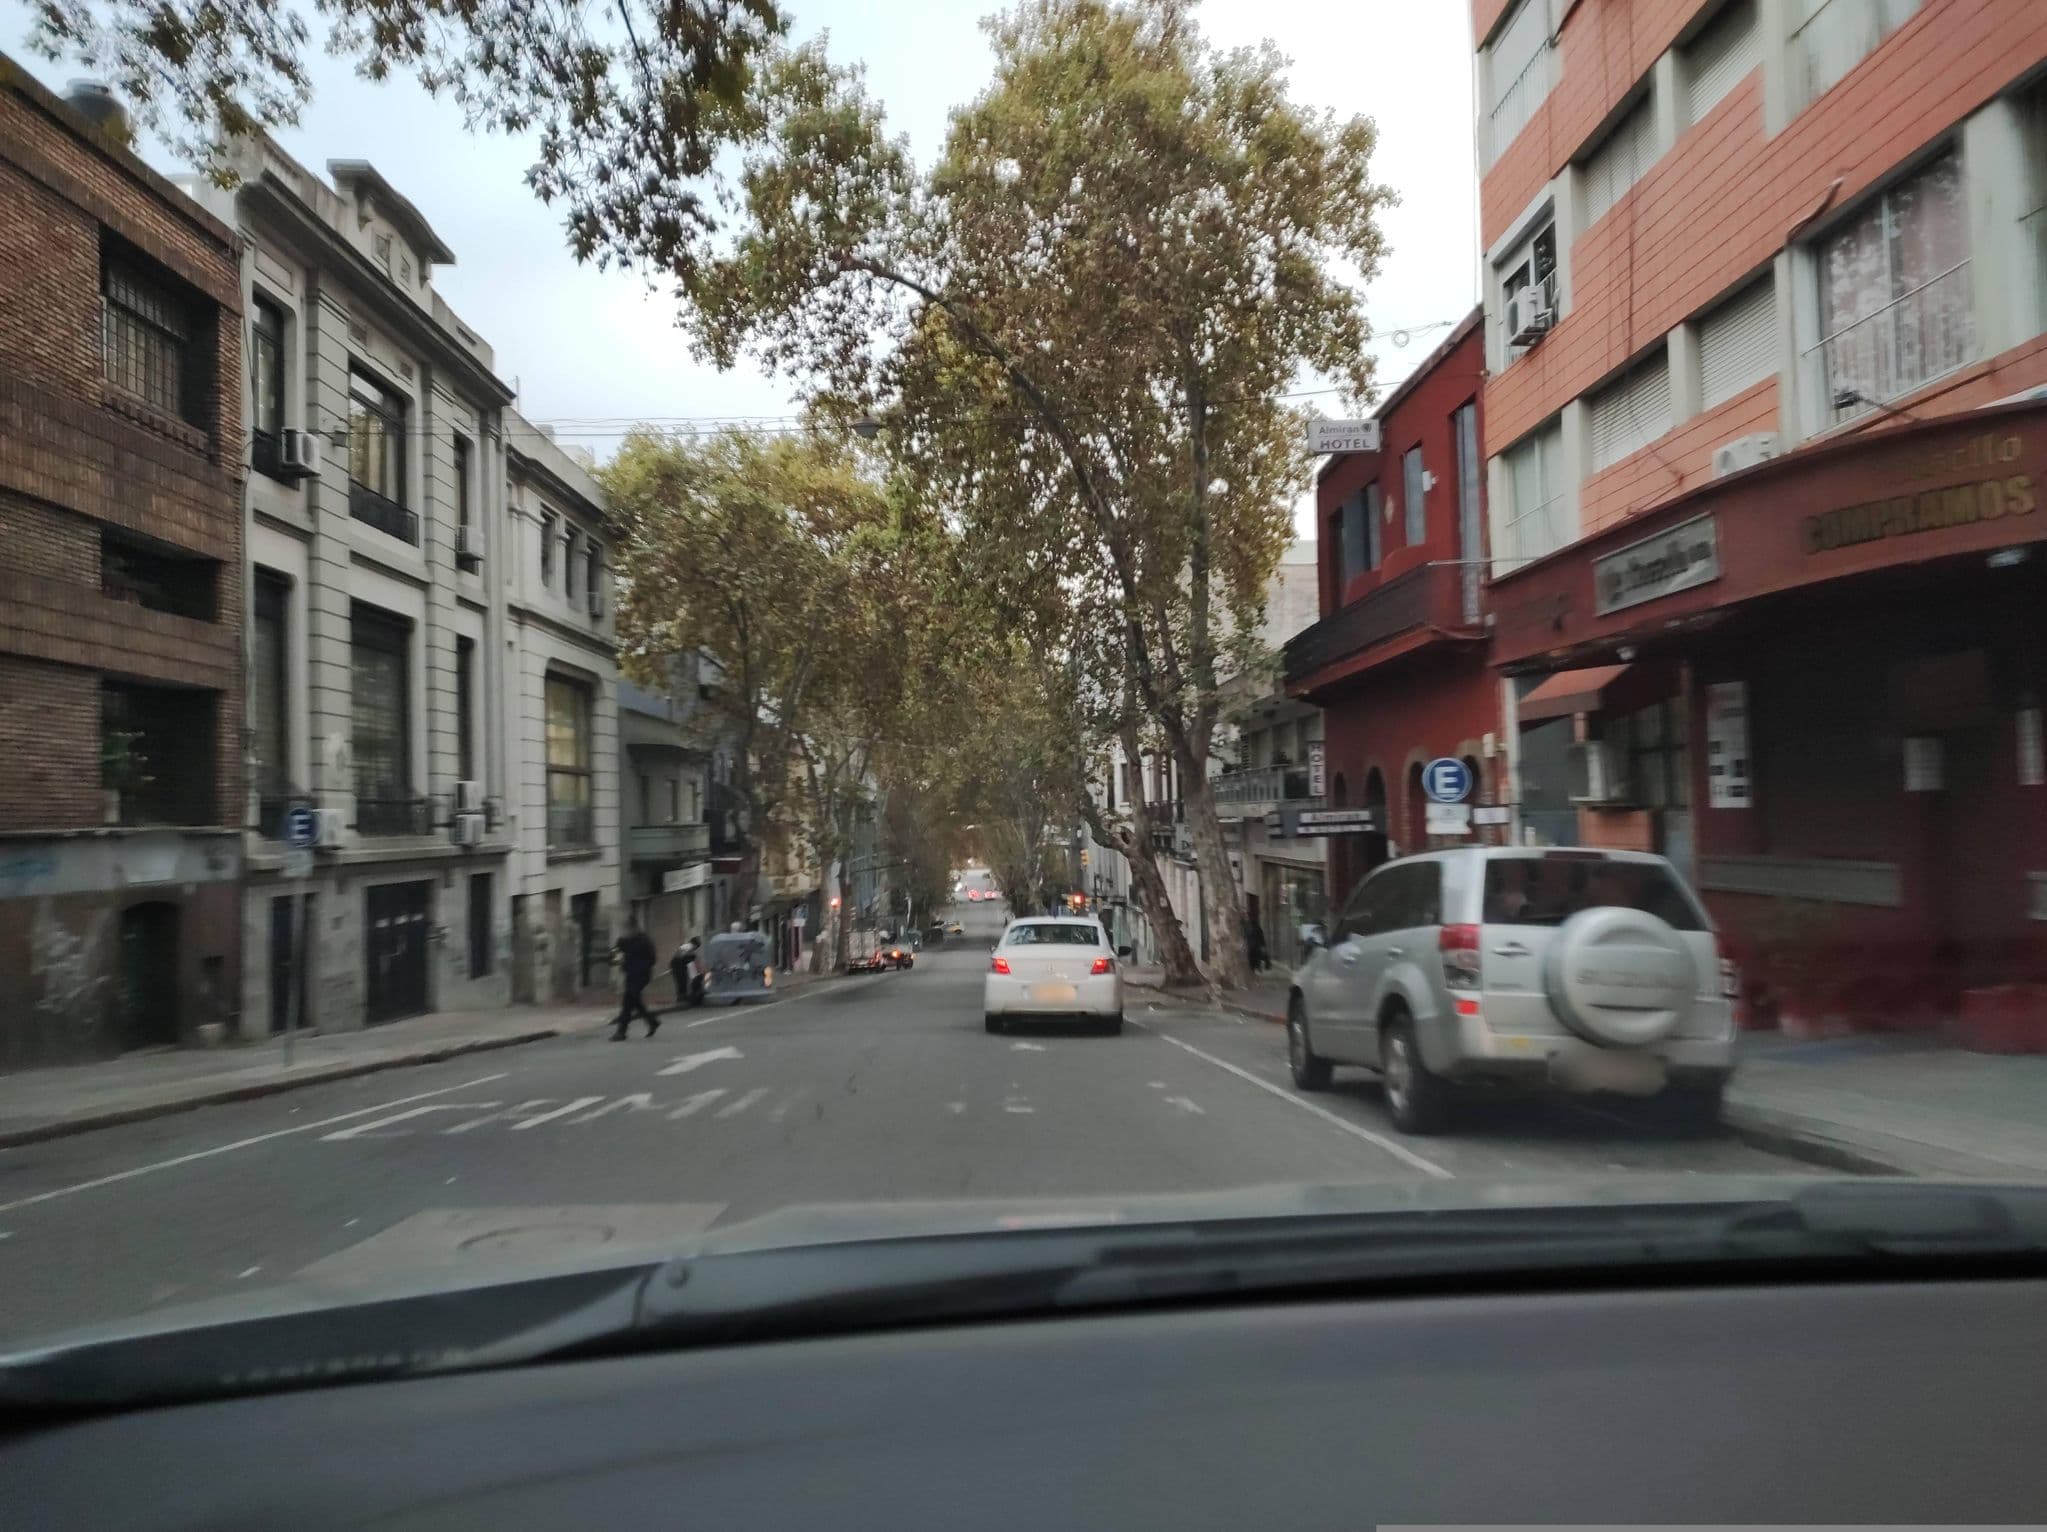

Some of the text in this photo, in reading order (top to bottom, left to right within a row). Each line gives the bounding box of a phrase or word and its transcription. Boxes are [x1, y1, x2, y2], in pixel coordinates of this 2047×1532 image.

[1319, 424, 1360, 434] Almiran
[1319, 438, 1371, 450] HOTEL
[1801, 474, 2036, 555] COMPRAMOS
[1310, 743, 1322, 794] HOTEL
[1434, 766, 1461, 793] E
[290, 815, 312, 840] E
